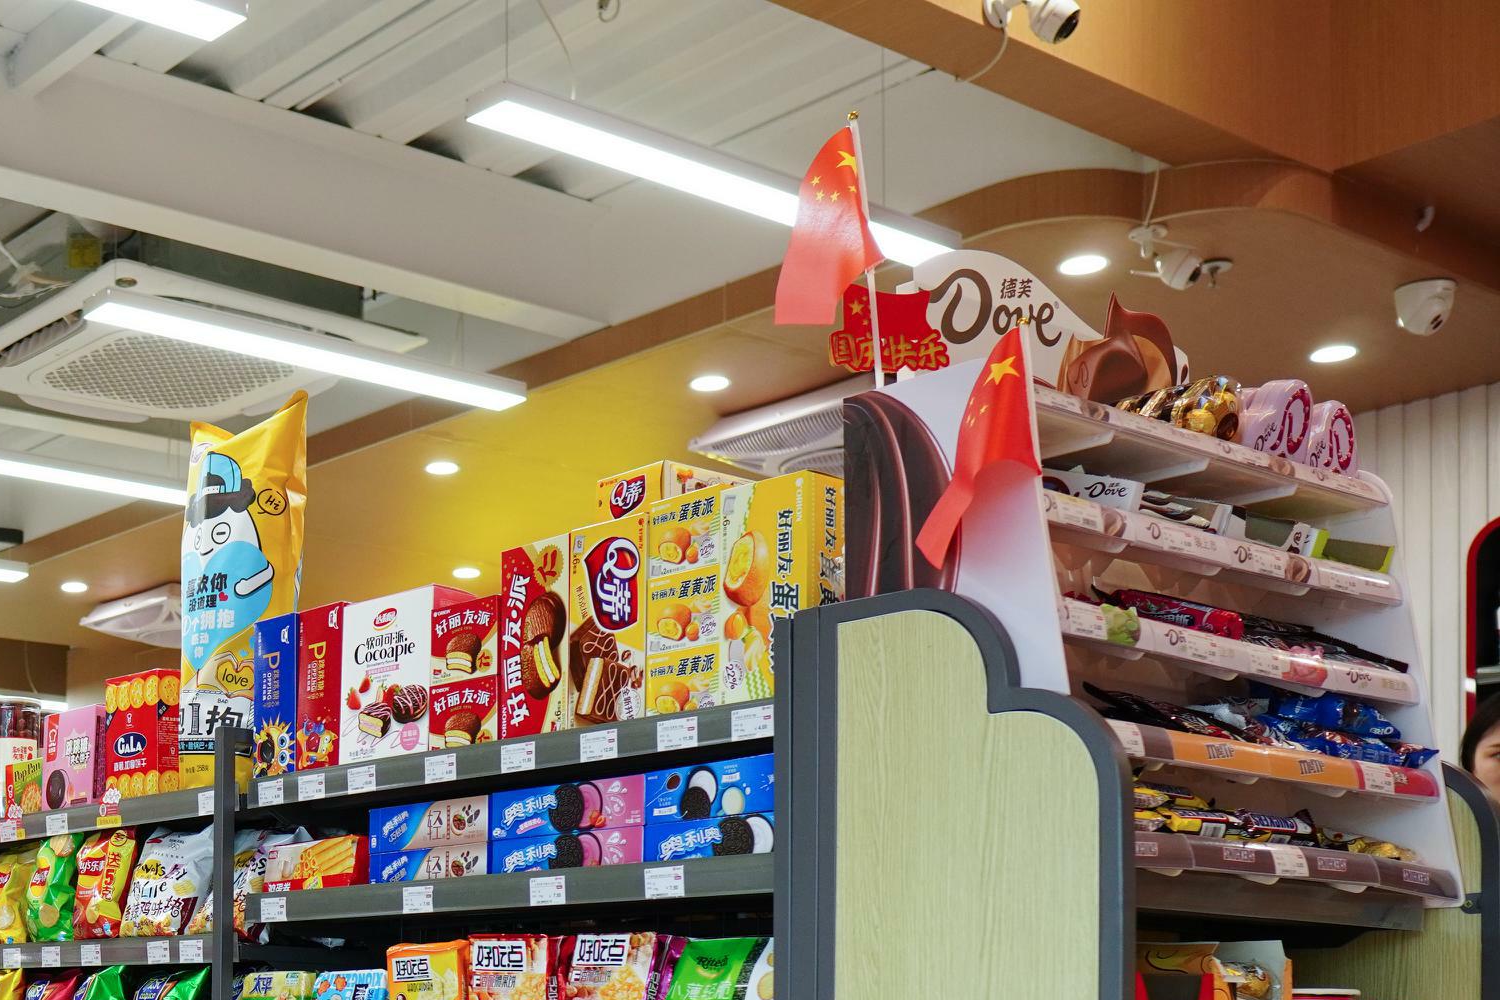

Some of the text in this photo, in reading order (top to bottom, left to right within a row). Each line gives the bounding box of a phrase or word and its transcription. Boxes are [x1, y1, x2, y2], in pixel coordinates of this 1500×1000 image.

[1000, 277, 1033, 299] 德芙
[919, 268, 1063, 347] Dove
[609, 480, 644, 508] Q蒂
[1085, 480, 1129, 498] Dove
[591, 537, 640, 623] Q蒂
[435, 608, 491, 640] 好丽友·派
[354, 638, 416, 667] Cocoapie
[502, 574, 531, 727] 好丽友·派
[220, 667, 250, 689] love
[433, 687, 491, 717] 好丽友·派
[14, 761, 42, 783] Pop Pan
[503, 794, 558, 826] 奥利奥
[428, 809, 444, 842] 轻
[503, 842, 558, 873] 奥利奥
[660, 827, 723, 861] 奥利奥
[475, 943, 526, 969] 好吃点
[576, 936, 628, 965] 好吃点
[394, 957, 429, 978] 好吃点
[248, 973, 273, 996] 太平
